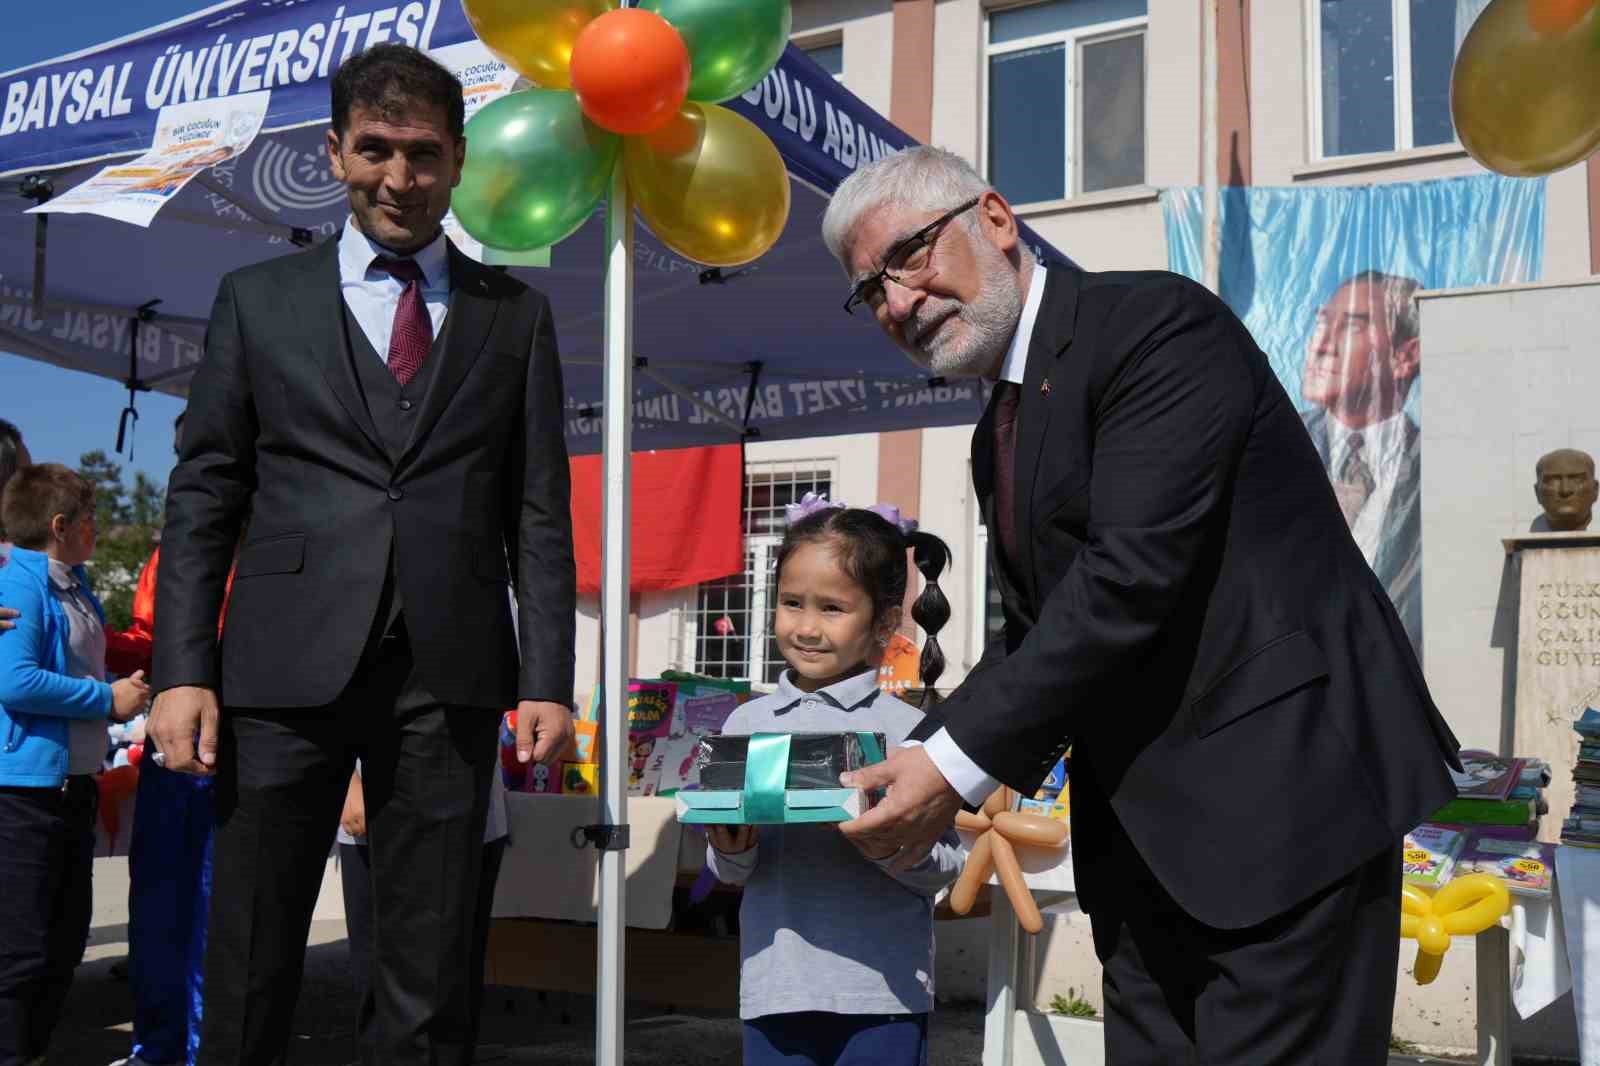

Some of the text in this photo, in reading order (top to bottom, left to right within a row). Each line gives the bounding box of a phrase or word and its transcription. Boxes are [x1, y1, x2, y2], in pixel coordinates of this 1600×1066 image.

[0, 62, 133, 136] BAYSAL
[822, 100, 899, 169] ABAN
[1537, 628, 1600, 647] ÇALI
